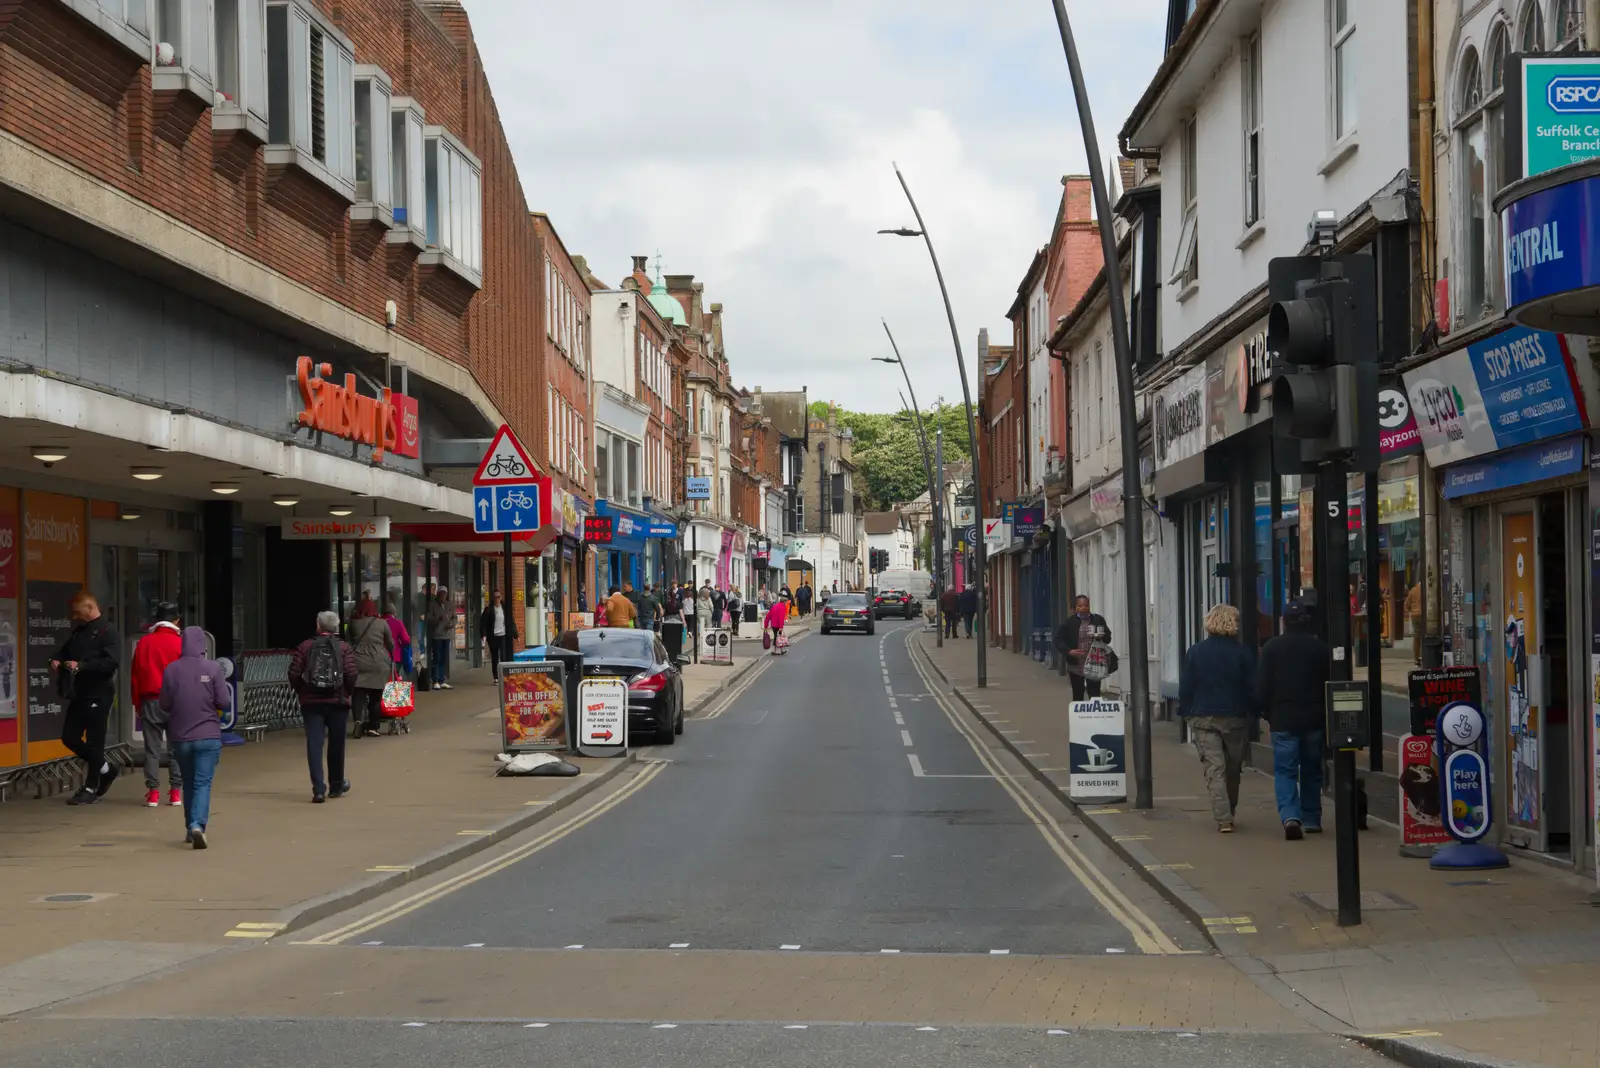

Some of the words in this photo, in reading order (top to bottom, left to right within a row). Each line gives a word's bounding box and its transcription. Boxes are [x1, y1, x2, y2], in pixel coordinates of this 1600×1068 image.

[1536, 124, 1581, 137] Suffolk
[1483, 344, 1513, 382] STOP
[1511, 332, 1547, 373] PRESS
[296, 355, 397, 462] Sainsbury's
[1420, 385, 1457, 432] Lyca
[1380, 428, 1421, 448] ayzone
[1328, 501, 1340, 517] 5
[24, 508, 80, 551] Sainsbury's
[292, 521, 377, 537] Sainsbury's
[1432, 672, 1449, 682] Spirit
[1449, 670, 1476, 678] Available
[1424, 678, 1466, 694] WINE
[508, 691, 533, 701] LUNCH
[535, 690, 559, 701] OFFER
[587, 702, 605, 712] BEST
[1073, 700, 1120, 713] LAVAZZA
[1453, 769, 1478, 782] Play
[1454, 780, 1479, 790] here
